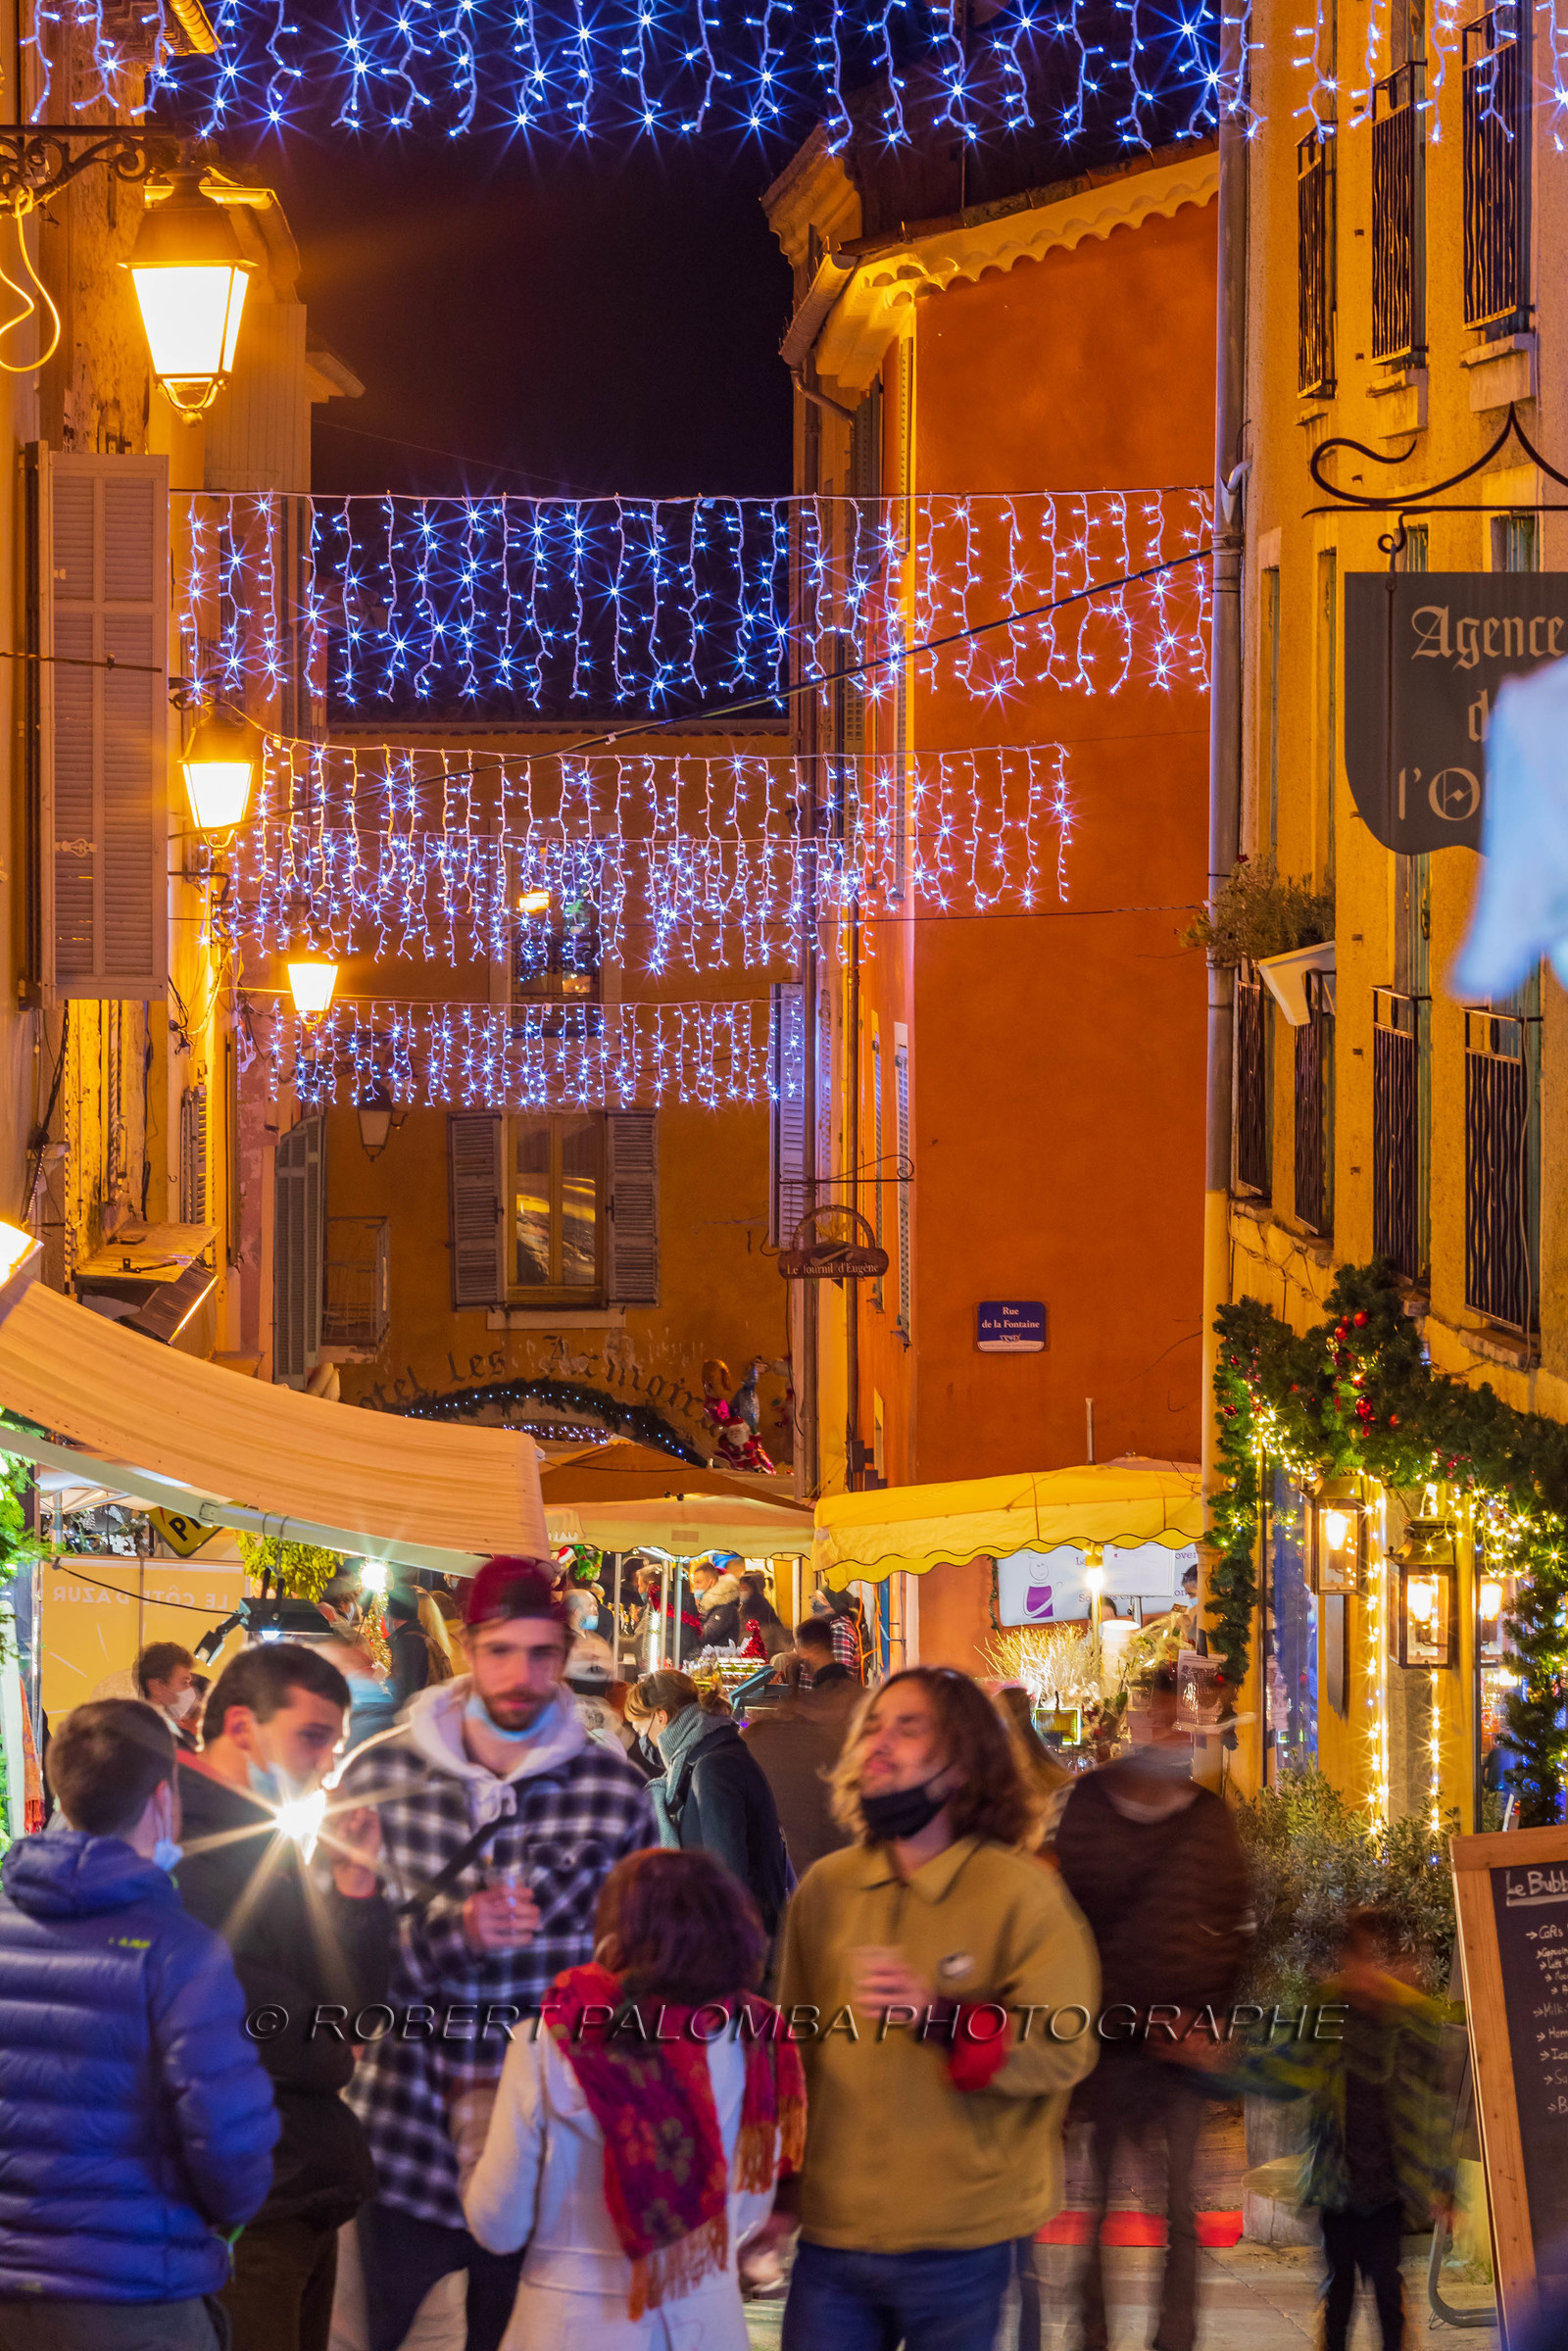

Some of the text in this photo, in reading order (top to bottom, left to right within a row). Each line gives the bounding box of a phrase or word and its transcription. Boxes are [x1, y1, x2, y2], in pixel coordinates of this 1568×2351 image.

[1411, 606, 1566, 670] Agence
[1468, 689, 1491, 742] d
[1398, 767, 1481, 820] l'O
[787, 1263, 799, 1275] Le
[981, 1319, 1040, 1328] de la Fontaine
[1003, 1306, 1019, 1315] Rue
[360, 1365, 429, 1411] ôtel
[1506, 1871, 1527, 1896] Le
